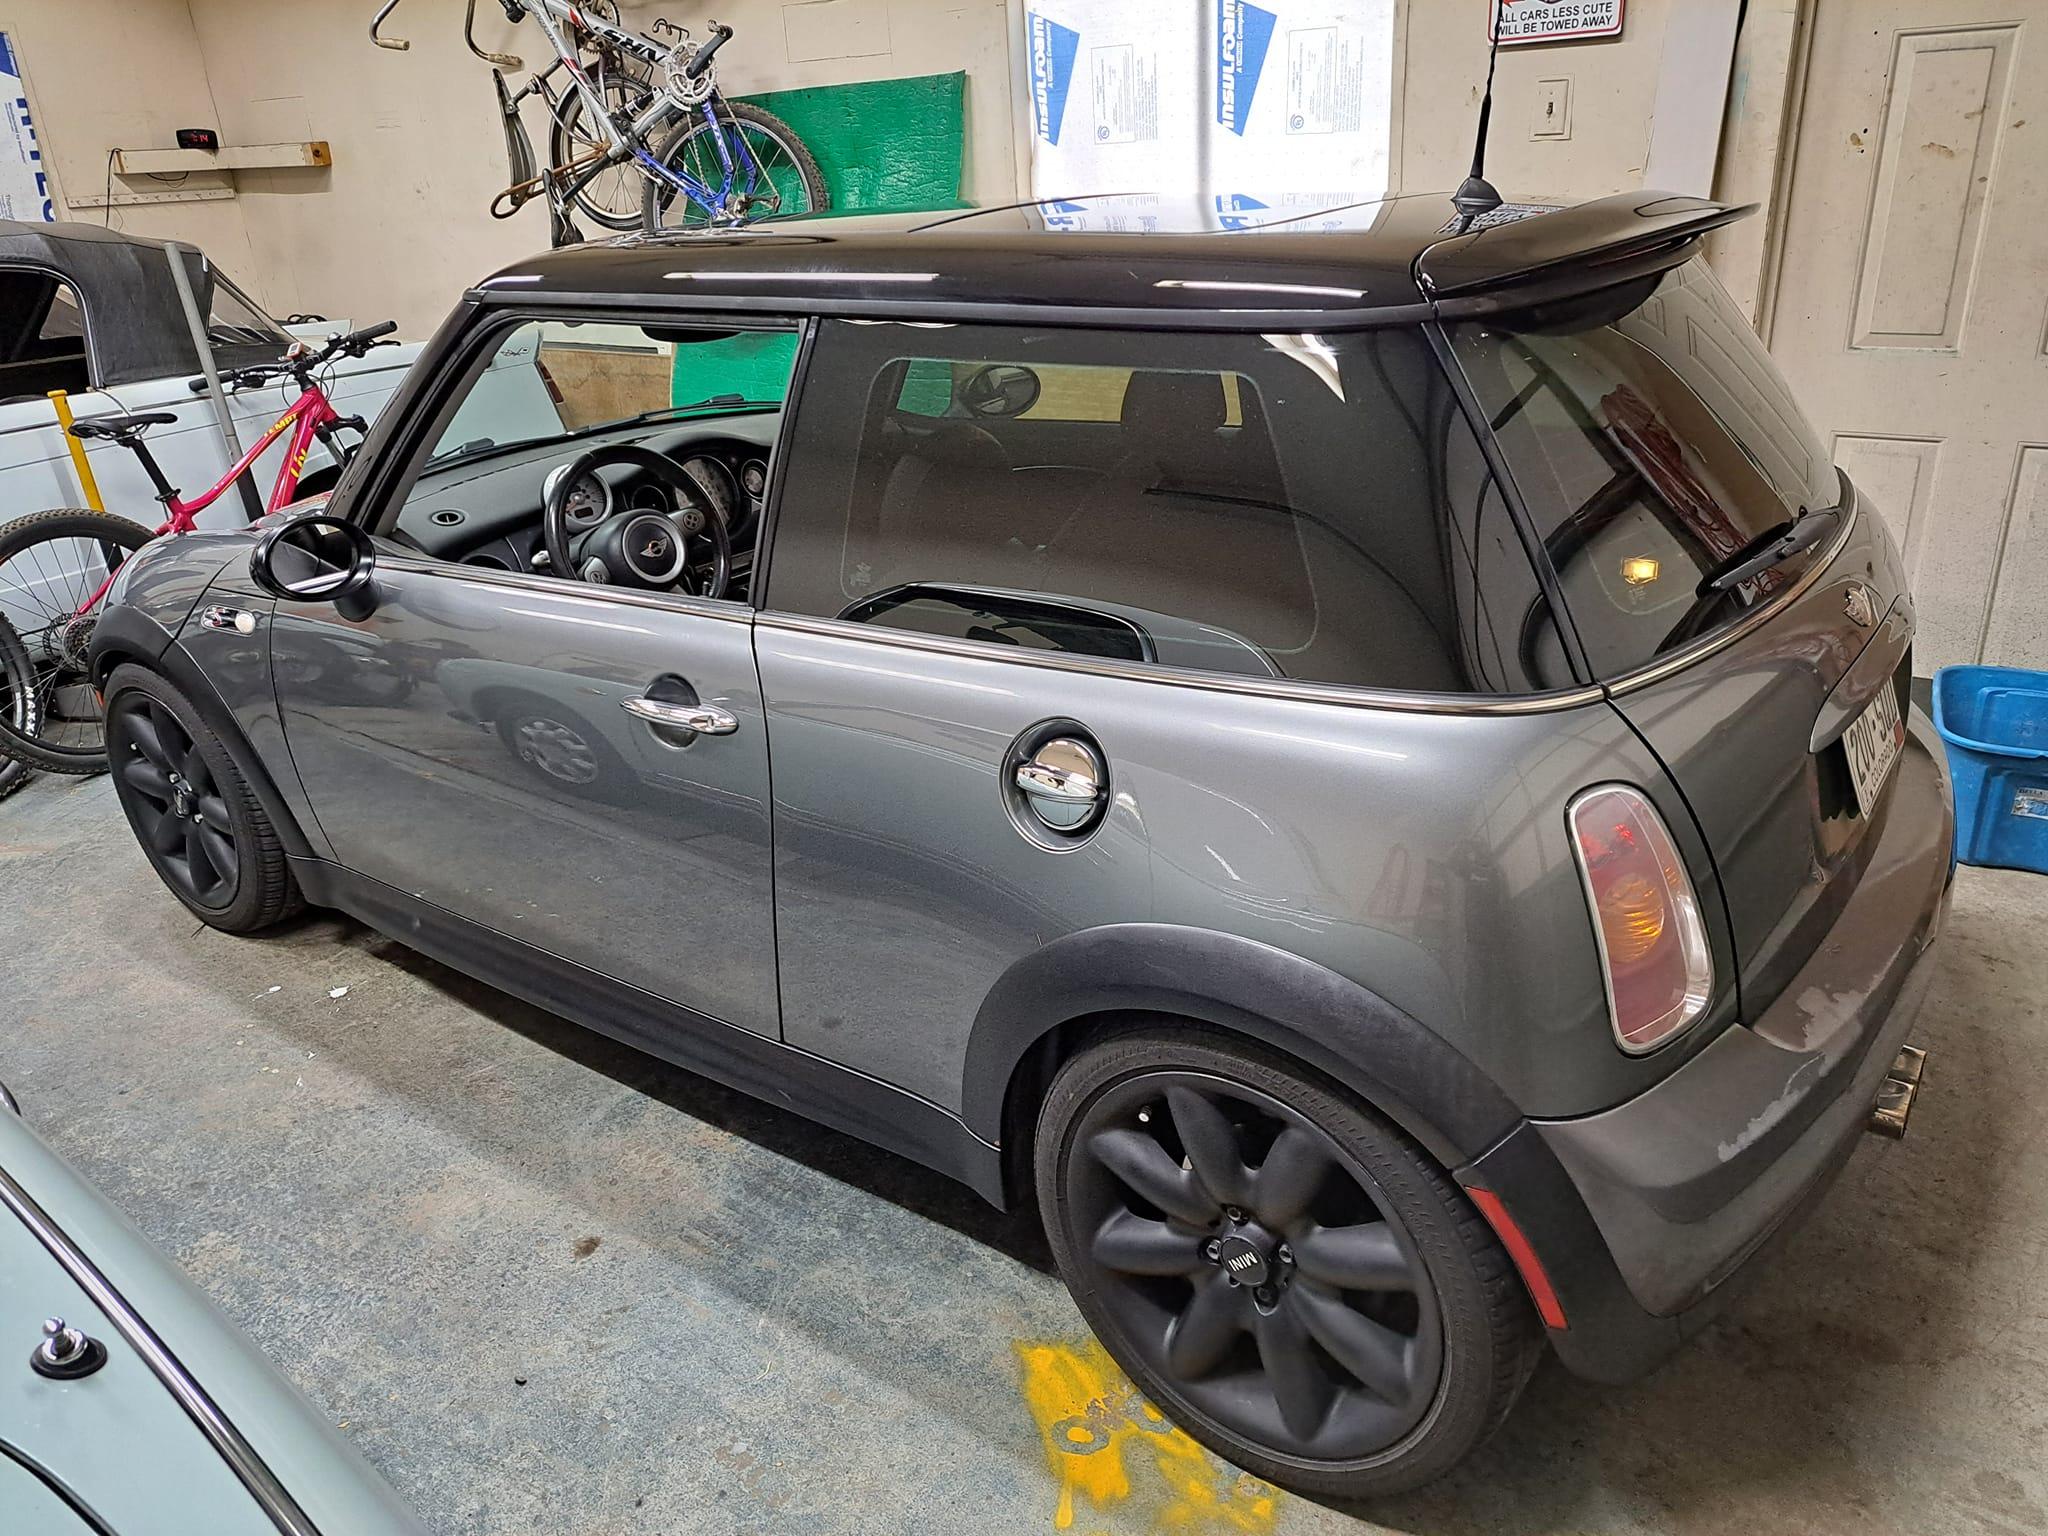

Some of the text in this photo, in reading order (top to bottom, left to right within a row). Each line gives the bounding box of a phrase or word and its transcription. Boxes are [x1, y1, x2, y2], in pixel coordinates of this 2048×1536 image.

[1499, 2, 1613, 23] ALL CARS LESS CUTE
[1523, 22, 1537, 34] BE
[1540, 18, 1579, 31] TOWED
[1581, 15, 1613, 28] AWAY
[25, 686, 36, 737] MAXXI
[1228, 1252, 1258, 1272] MINI
